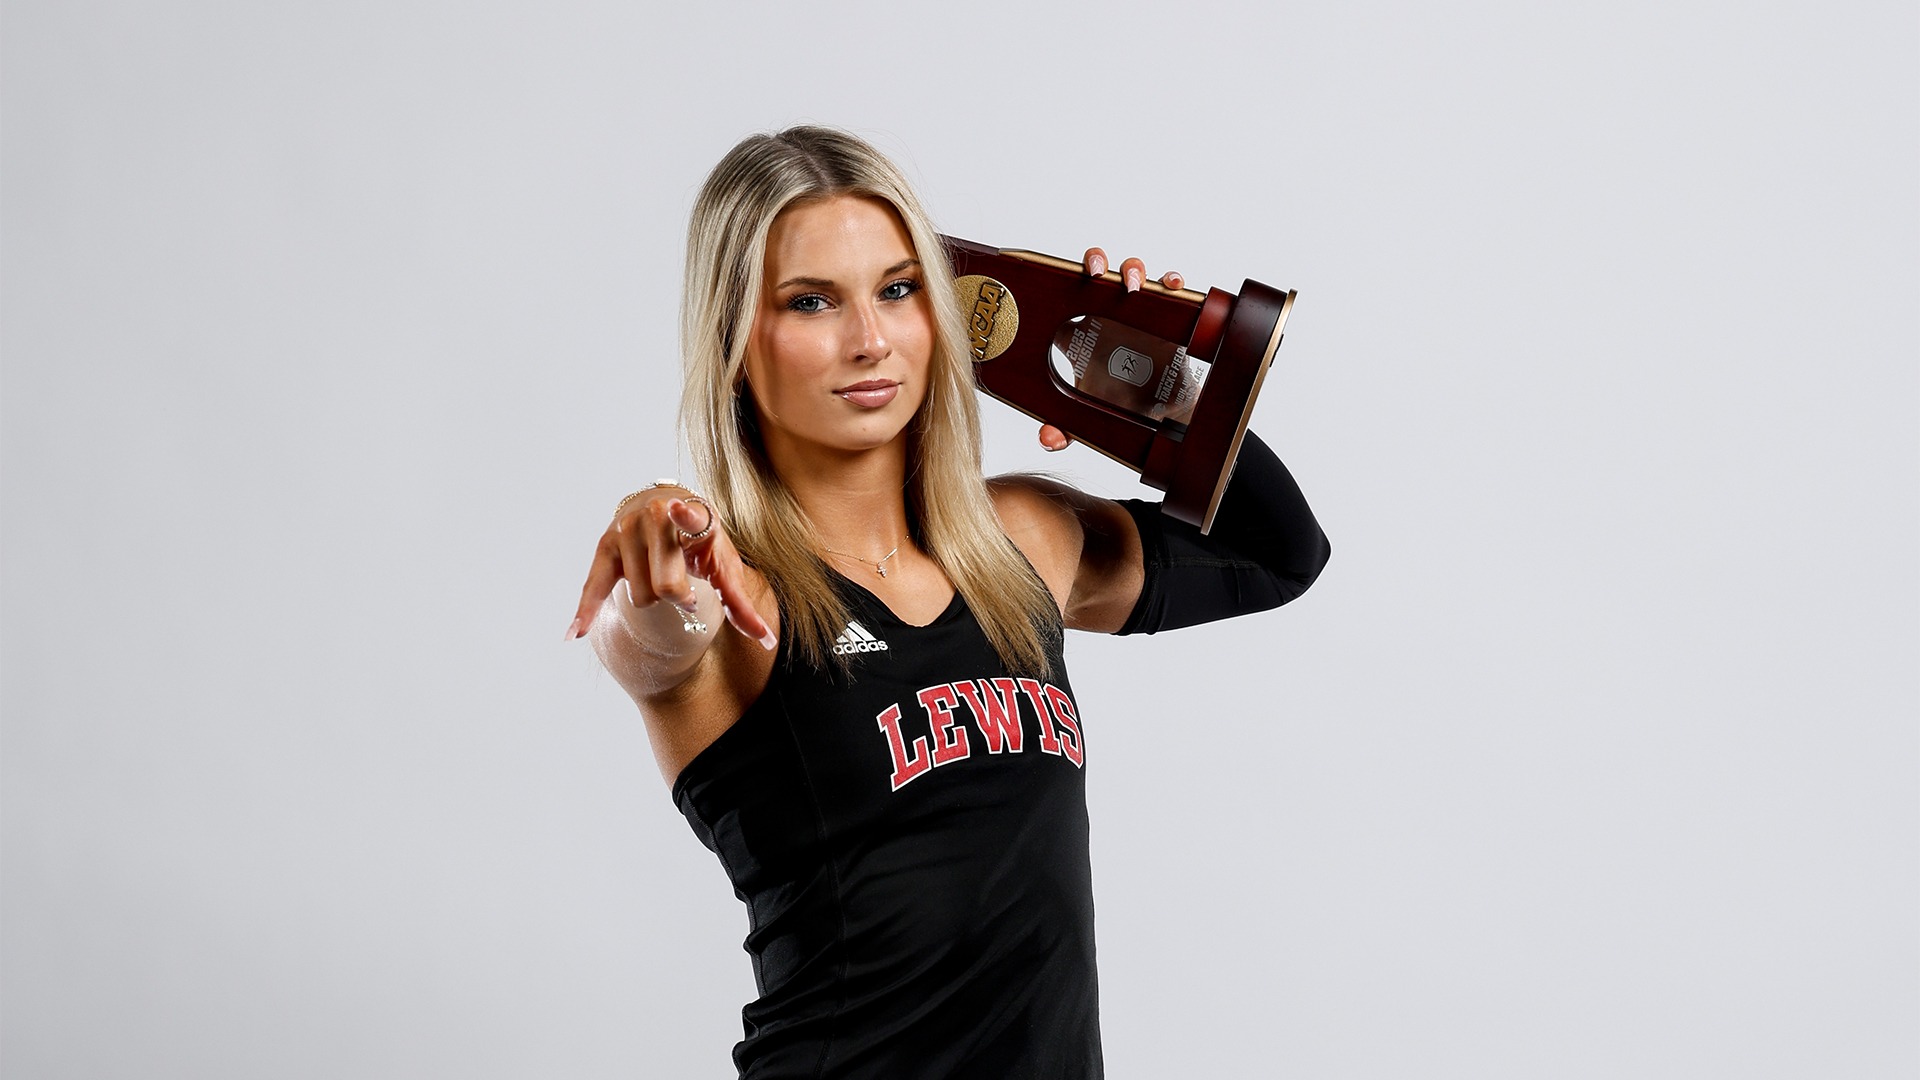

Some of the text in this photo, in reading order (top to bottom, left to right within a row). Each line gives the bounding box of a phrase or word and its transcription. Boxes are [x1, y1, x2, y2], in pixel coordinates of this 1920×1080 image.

[967, 282, 1006, 360] NCAA
[1066, 328, 1086, 361] 2025
[1074, 329, 1100, 380] DIVISION
[1158, 347, 1187, 403] TRACK & FIELD
[833, 640, 889, 655] adidas
[876, 677, 1084, 792] LEWIS
